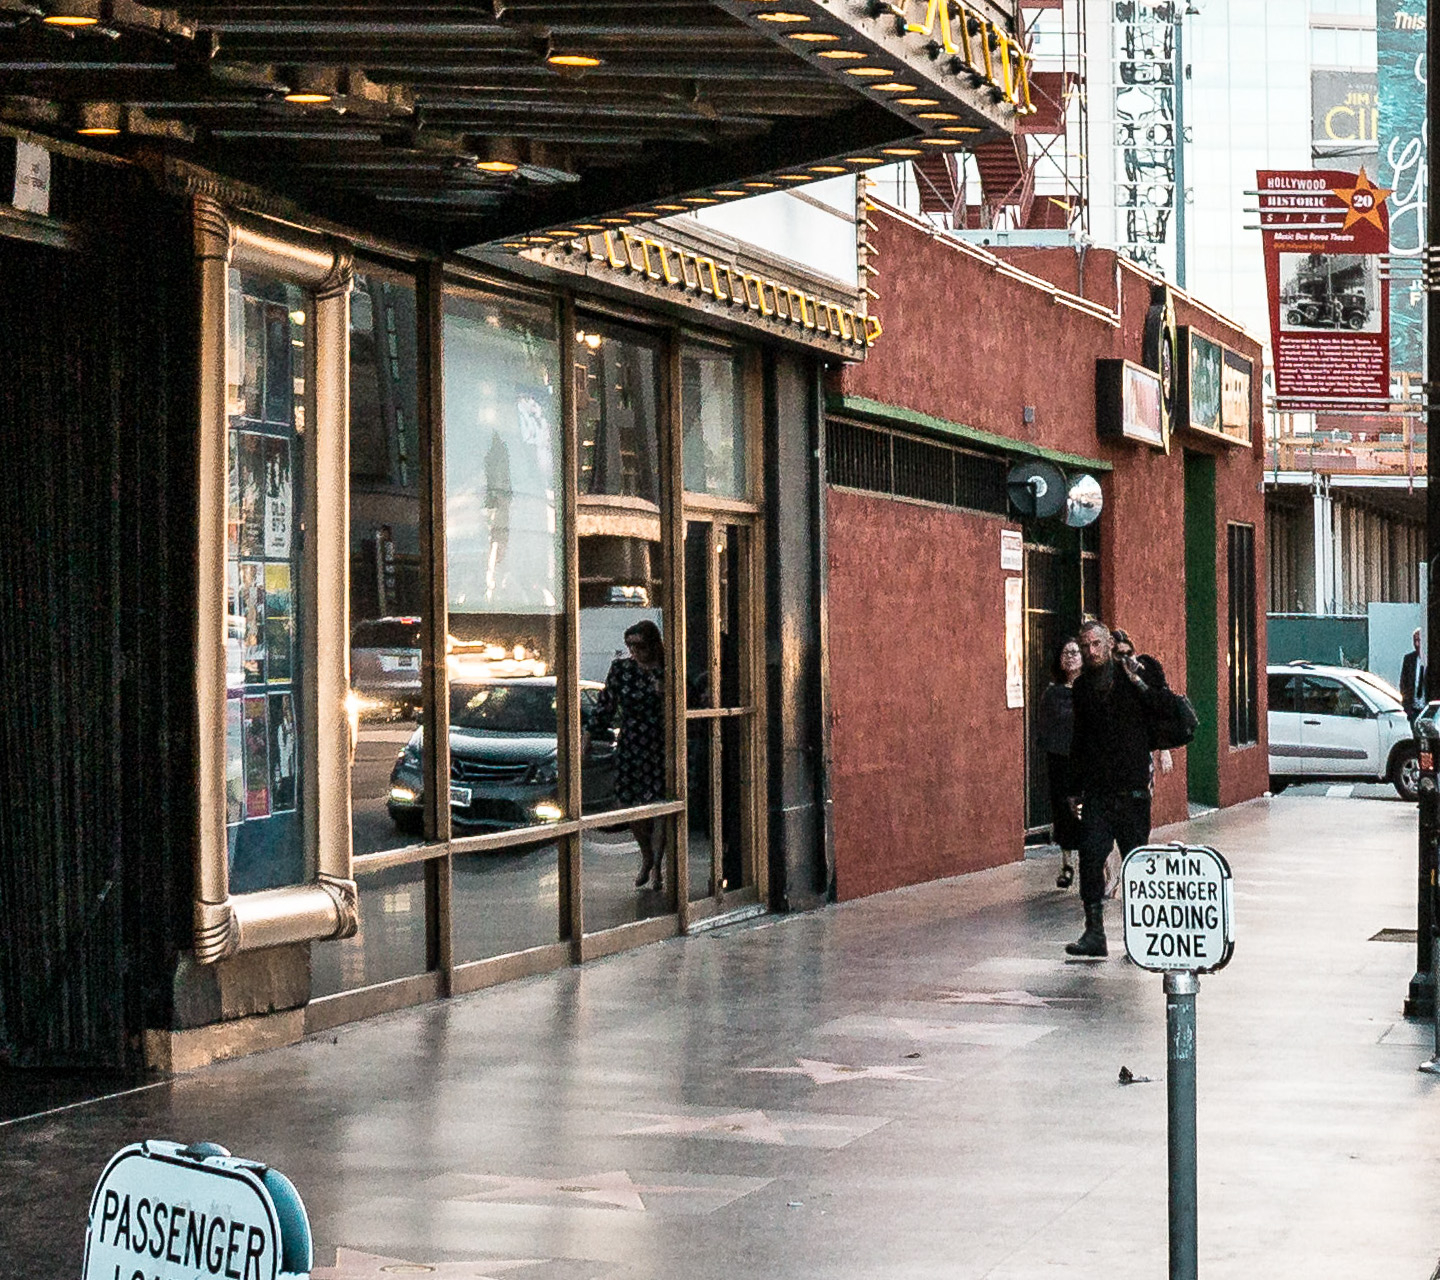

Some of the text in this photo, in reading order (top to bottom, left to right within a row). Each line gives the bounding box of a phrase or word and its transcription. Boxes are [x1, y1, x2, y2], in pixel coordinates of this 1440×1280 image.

[1395, 11, 1427, 30] This
[1344, 92, 1370, 105] JIM
[1267, 177, 1326, 190] HOLLYWOOD
[1267, 195, 1373, 207] HISTORIC 20
[1145, 858, 1206, 877] 3 MIN.
[1129, 880, 1218, 901] PASSENGER
[1130, 903, 1219, 930] LOADING
[1145, 933, 1207, 958] ZONE
[99, 1189, 266, 1280] PASSENGER
